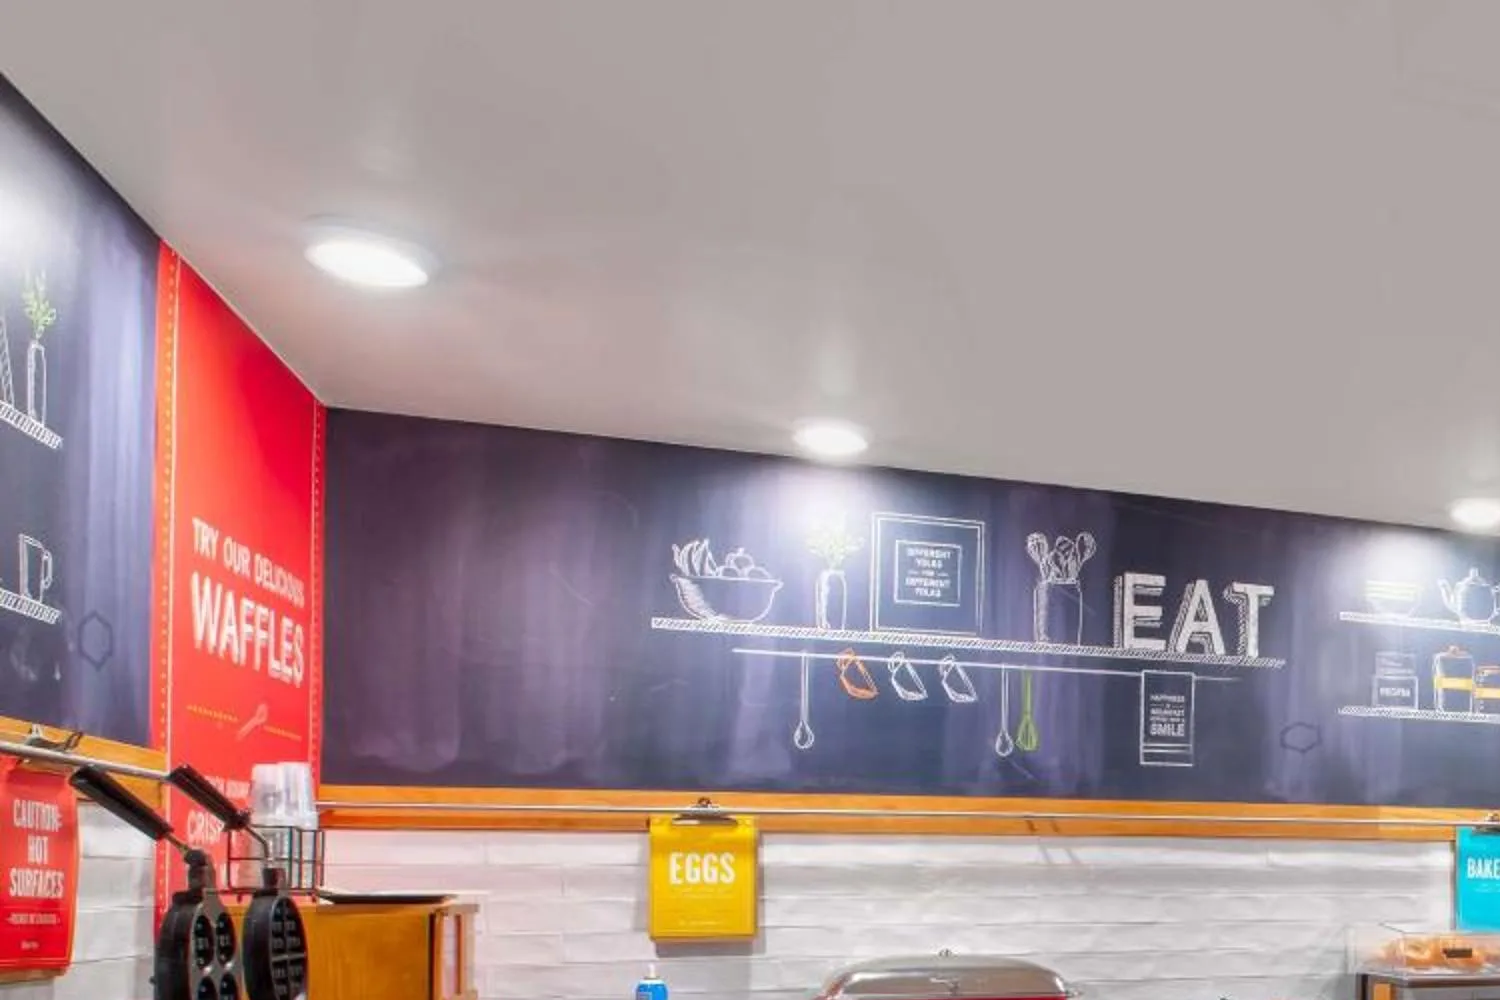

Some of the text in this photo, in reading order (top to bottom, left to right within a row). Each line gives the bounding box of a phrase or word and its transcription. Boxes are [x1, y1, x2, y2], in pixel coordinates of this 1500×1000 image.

[191, 516, 305, 608] TRY OUR DELICIOUS
[190, 571, 305, 688] WAFFLES
[1113, 571, 1275, 659] EAT
[27, 835, 49, 865] HOT
[669, 851, 737, 886] EGGS
[9, 866, 65, 899] SURFACES
